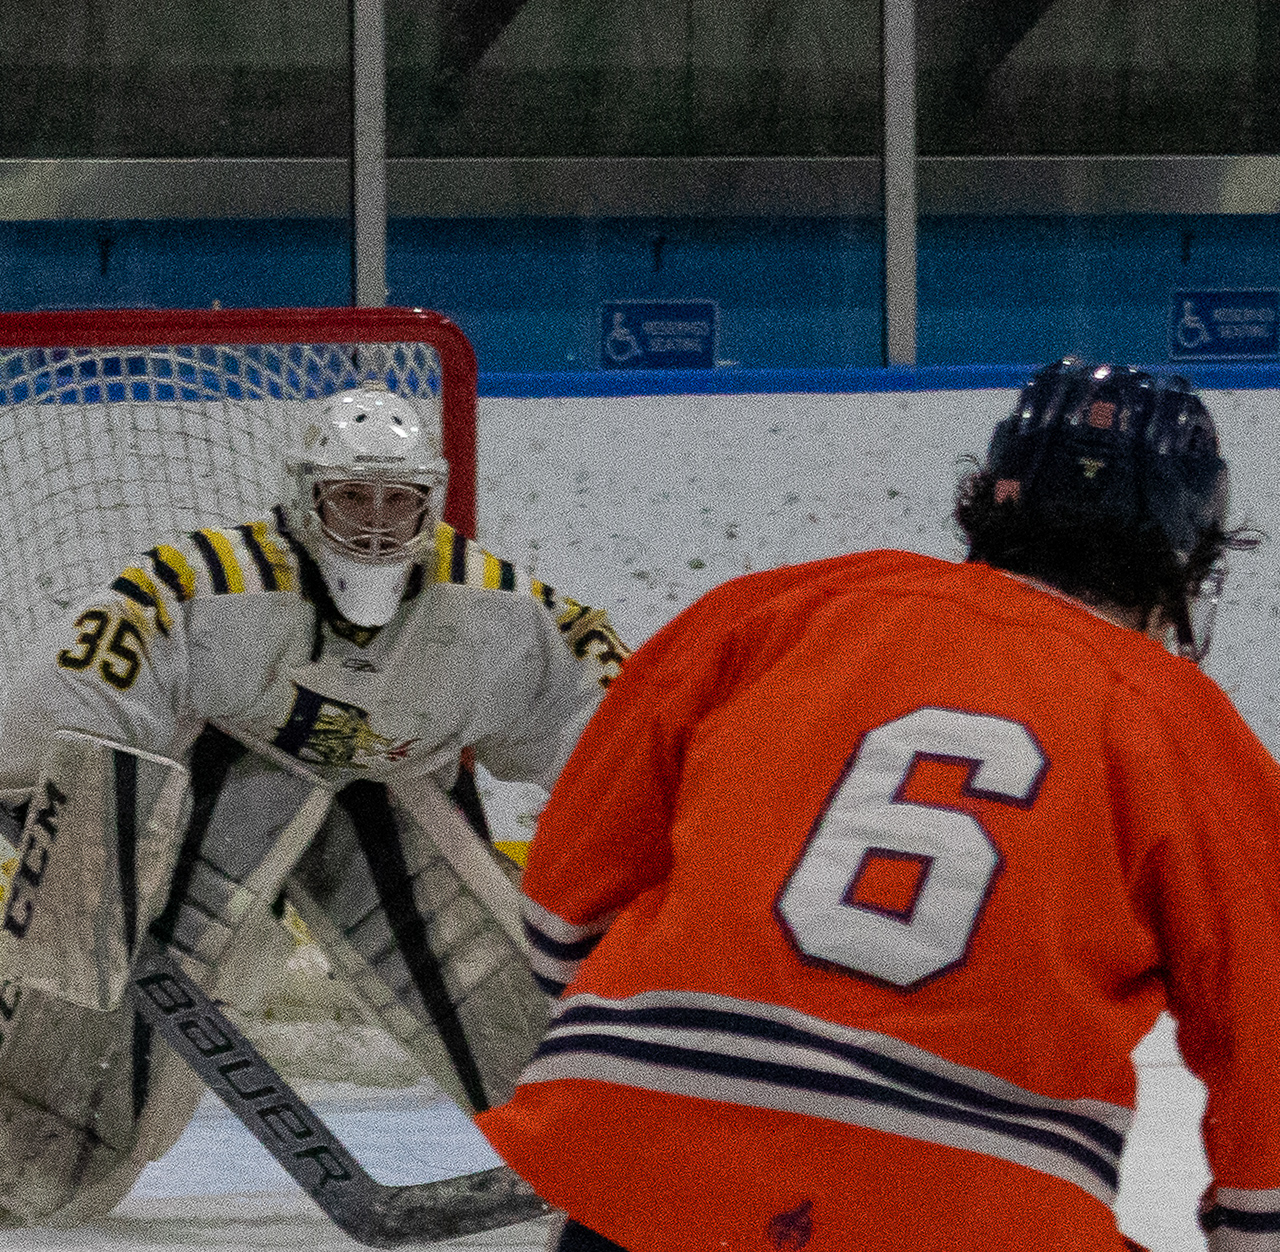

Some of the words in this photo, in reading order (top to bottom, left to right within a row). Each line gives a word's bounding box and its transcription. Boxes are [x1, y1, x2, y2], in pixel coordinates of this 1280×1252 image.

[55, 607, 142, 692] 35
[3, 778, 67, 941] CCM
[772, 705, 1048, 993] 6
